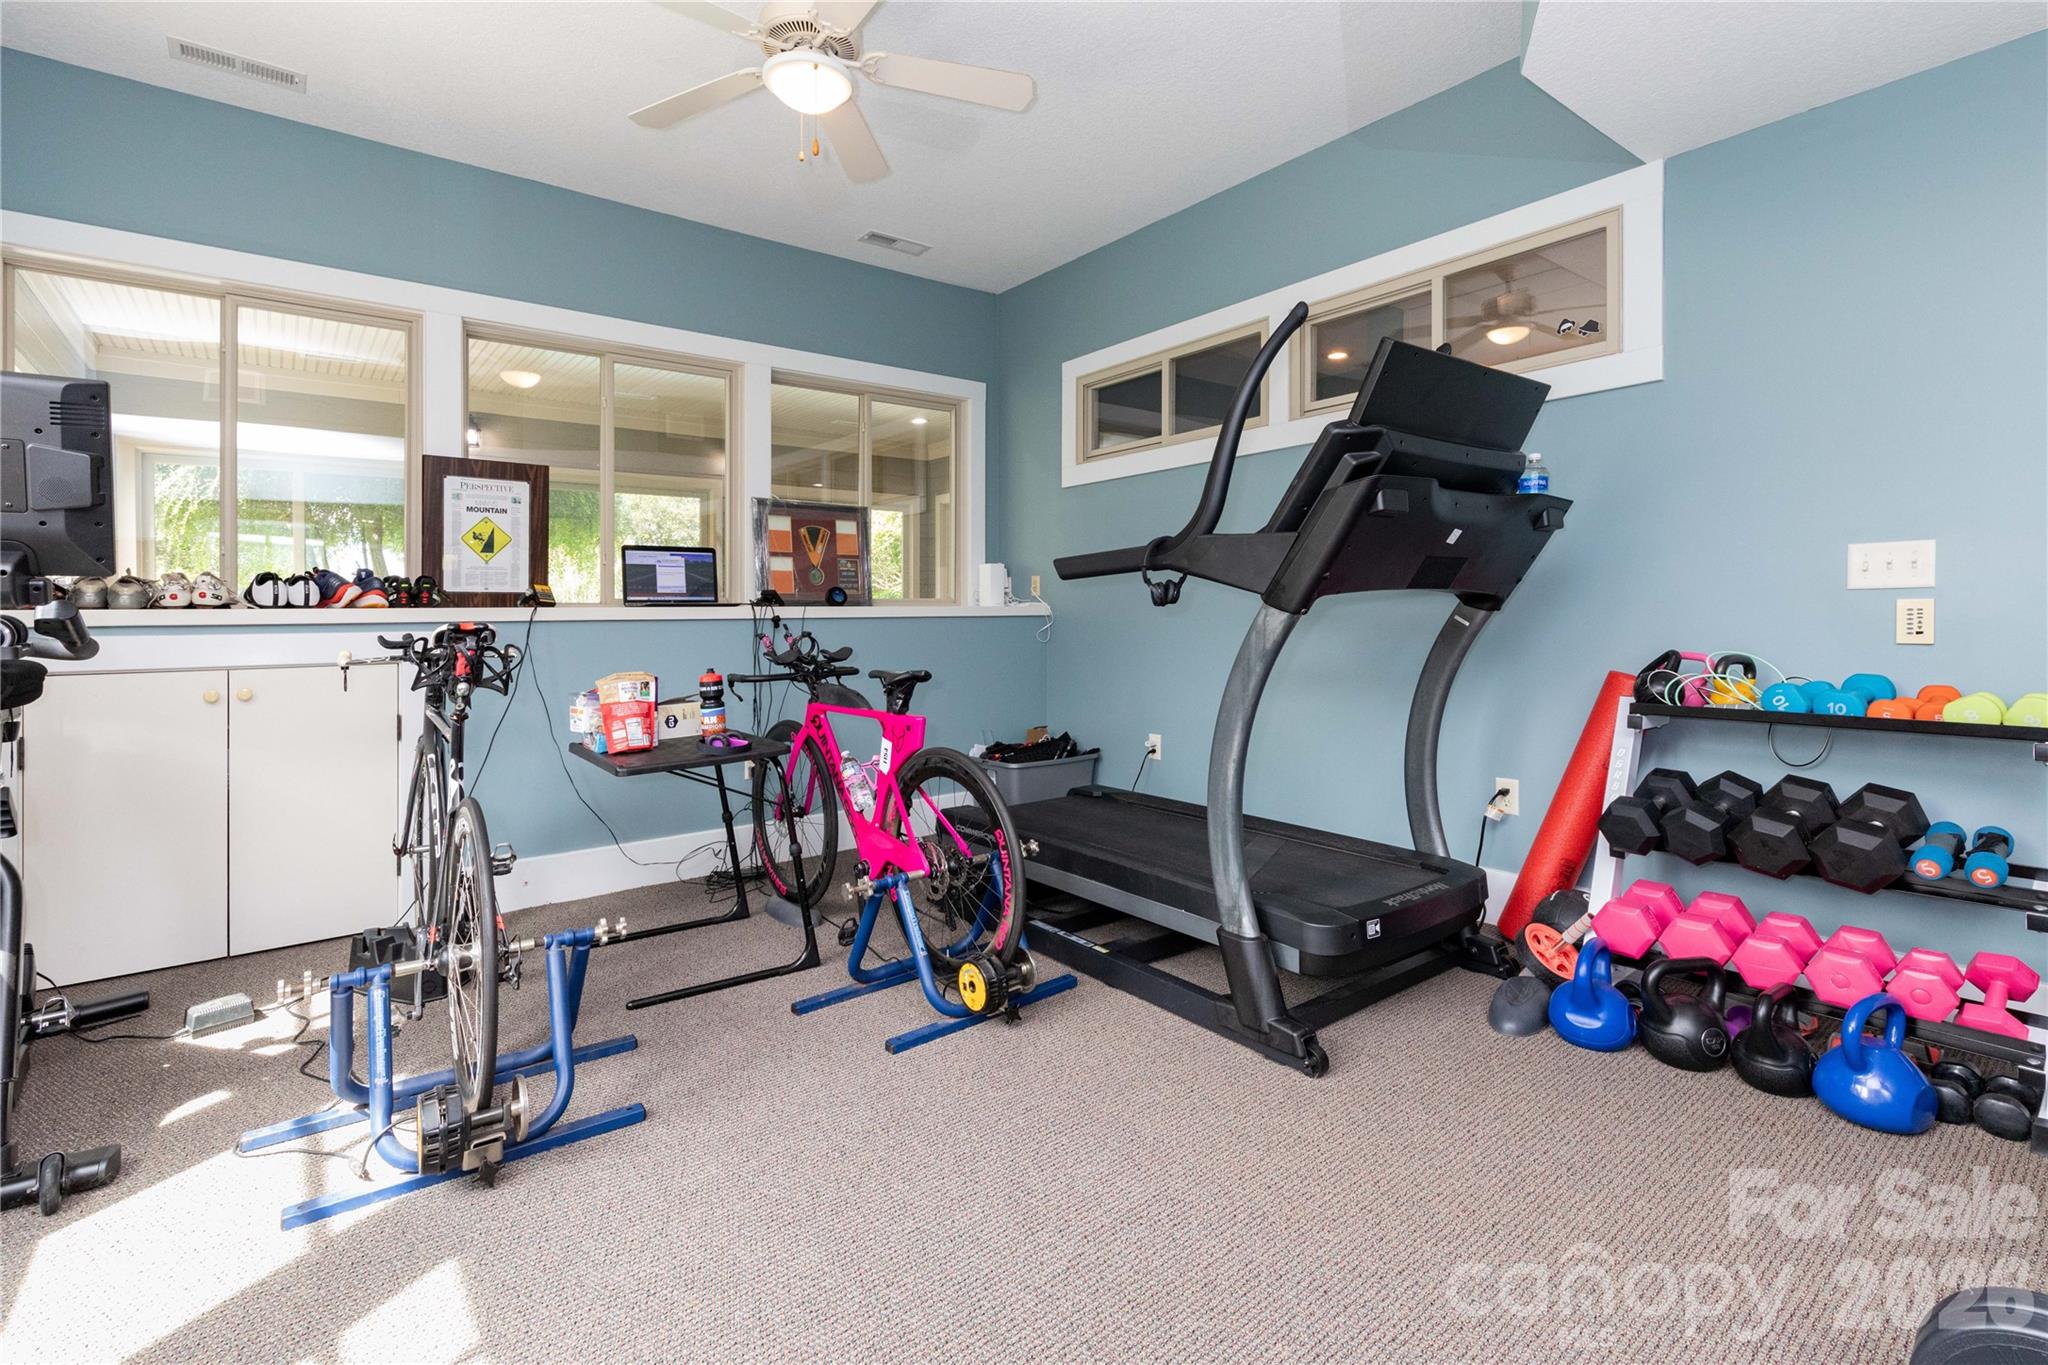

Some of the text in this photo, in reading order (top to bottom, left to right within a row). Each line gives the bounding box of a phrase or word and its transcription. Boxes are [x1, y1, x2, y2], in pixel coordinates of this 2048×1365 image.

[460, 481, 514, 493] PERSPECTIVE
[466, 505, 507, 515] MOUNTAIN
[1827, 702, 1847, 715] 10
[993, 828, 1012, 917] QUINTANA
[1920, 861, 1936, 877] 5
[1976, 868, 1993, 884] 5
